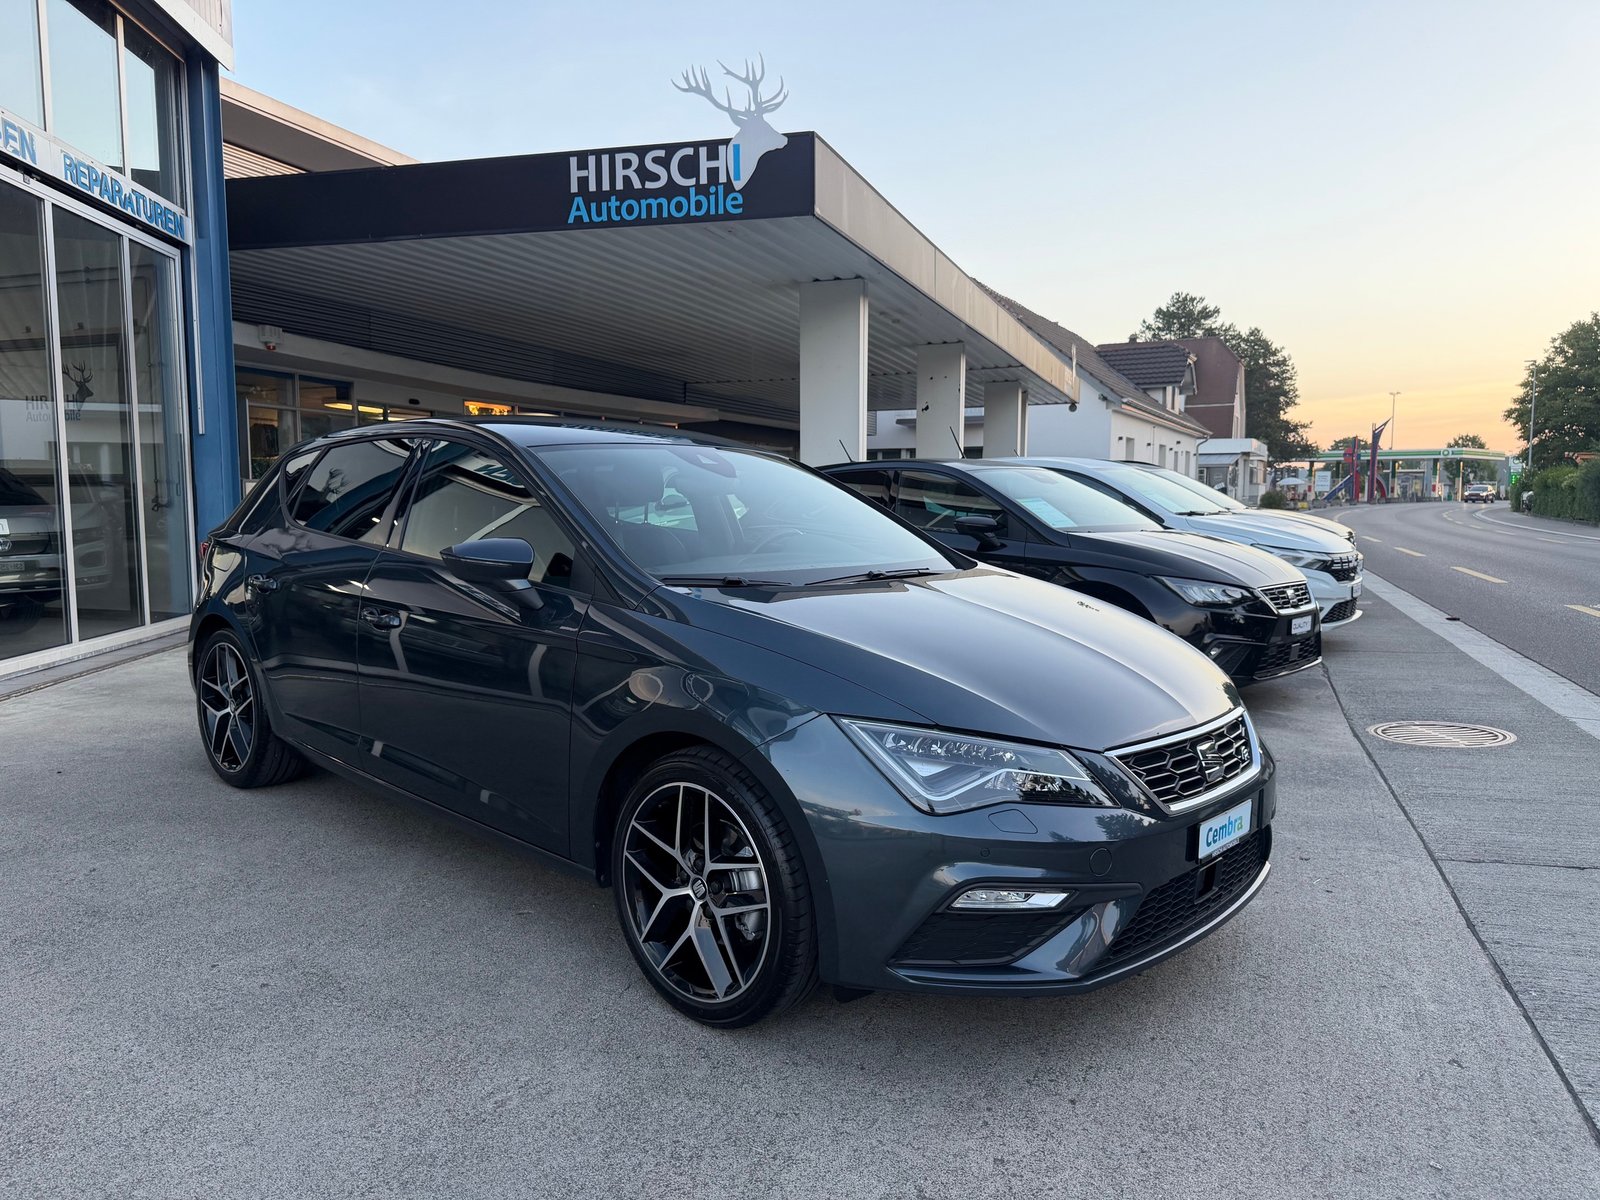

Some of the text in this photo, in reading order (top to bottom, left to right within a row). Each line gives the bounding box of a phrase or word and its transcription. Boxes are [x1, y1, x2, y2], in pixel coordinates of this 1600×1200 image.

[0, 117, 37, 165] EN
[62, 152, 186, 240] REPARATUREN
[567, 184, 744, 224] Automobile
[1206, 816, 1243, 847] Cembra
